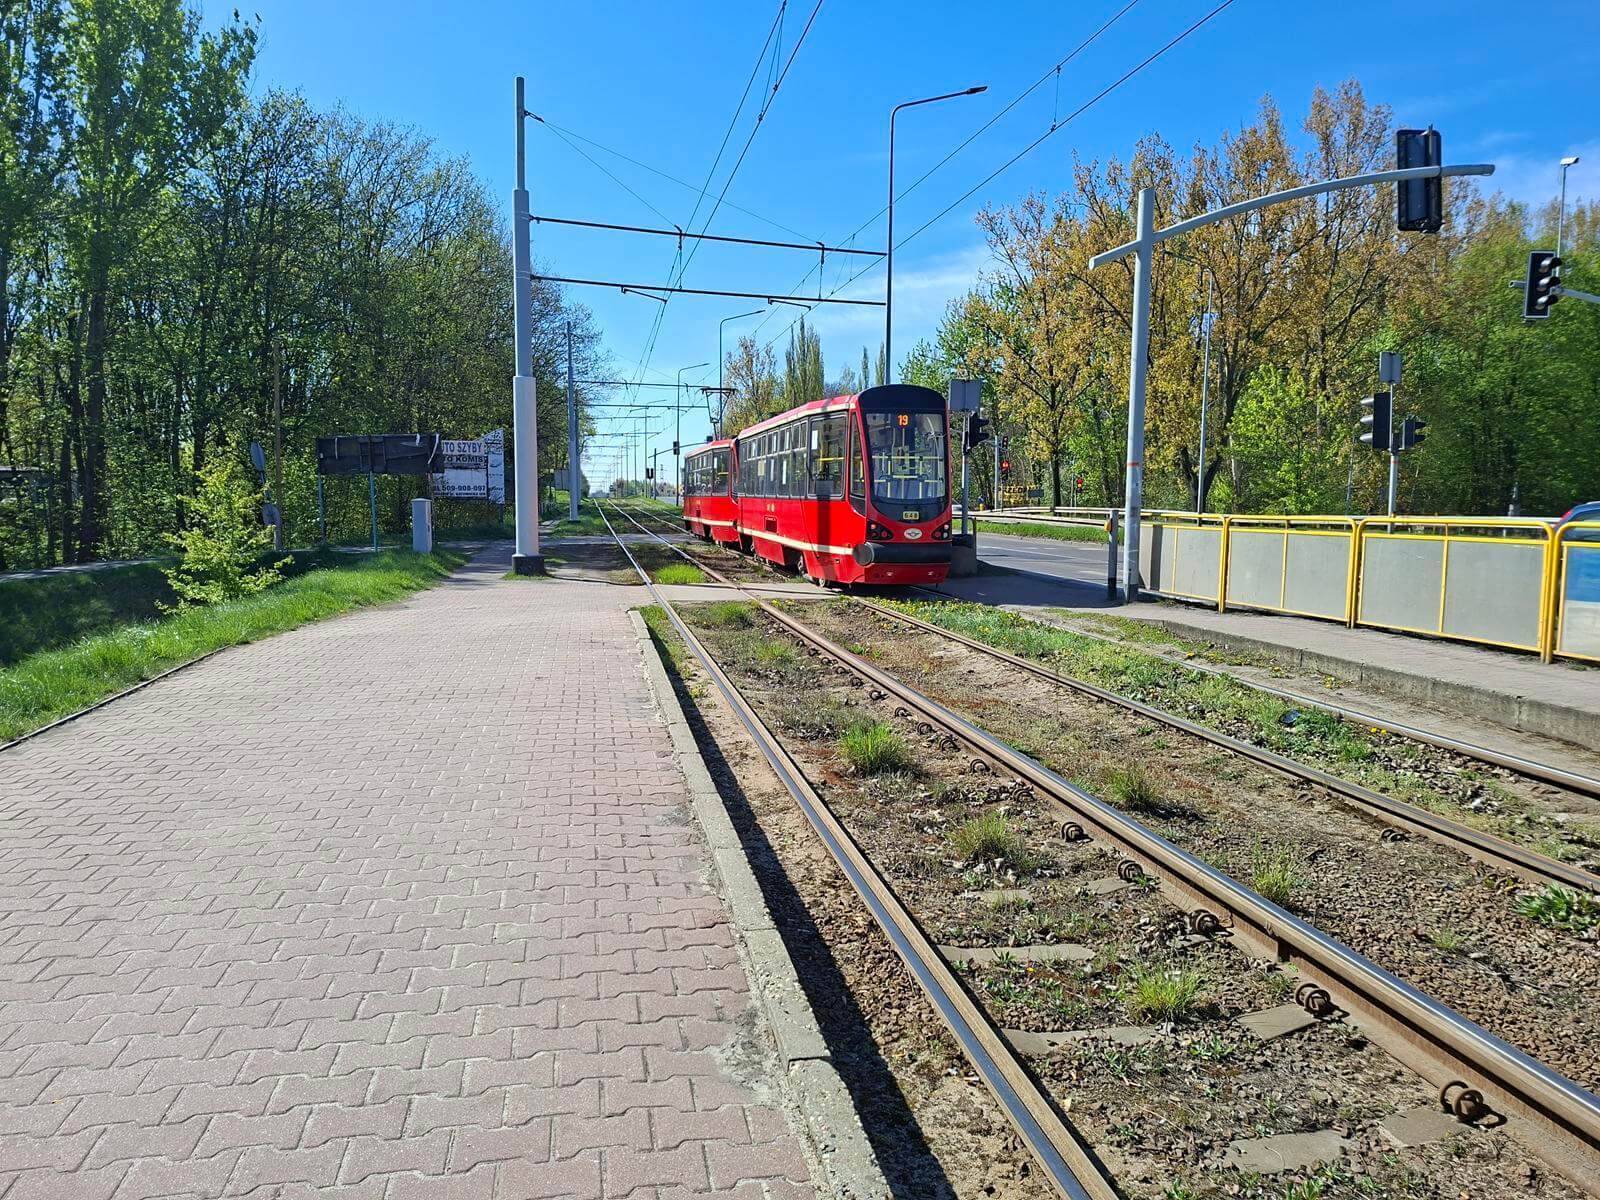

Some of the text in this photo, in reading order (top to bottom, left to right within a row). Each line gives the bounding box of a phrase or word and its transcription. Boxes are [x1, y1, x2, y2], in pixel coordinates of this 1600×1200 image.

[897, 414, 909, 426] 19
[457, 442, 482, 453] SZYBY
[455, 454, 483, 463] KOMIS
